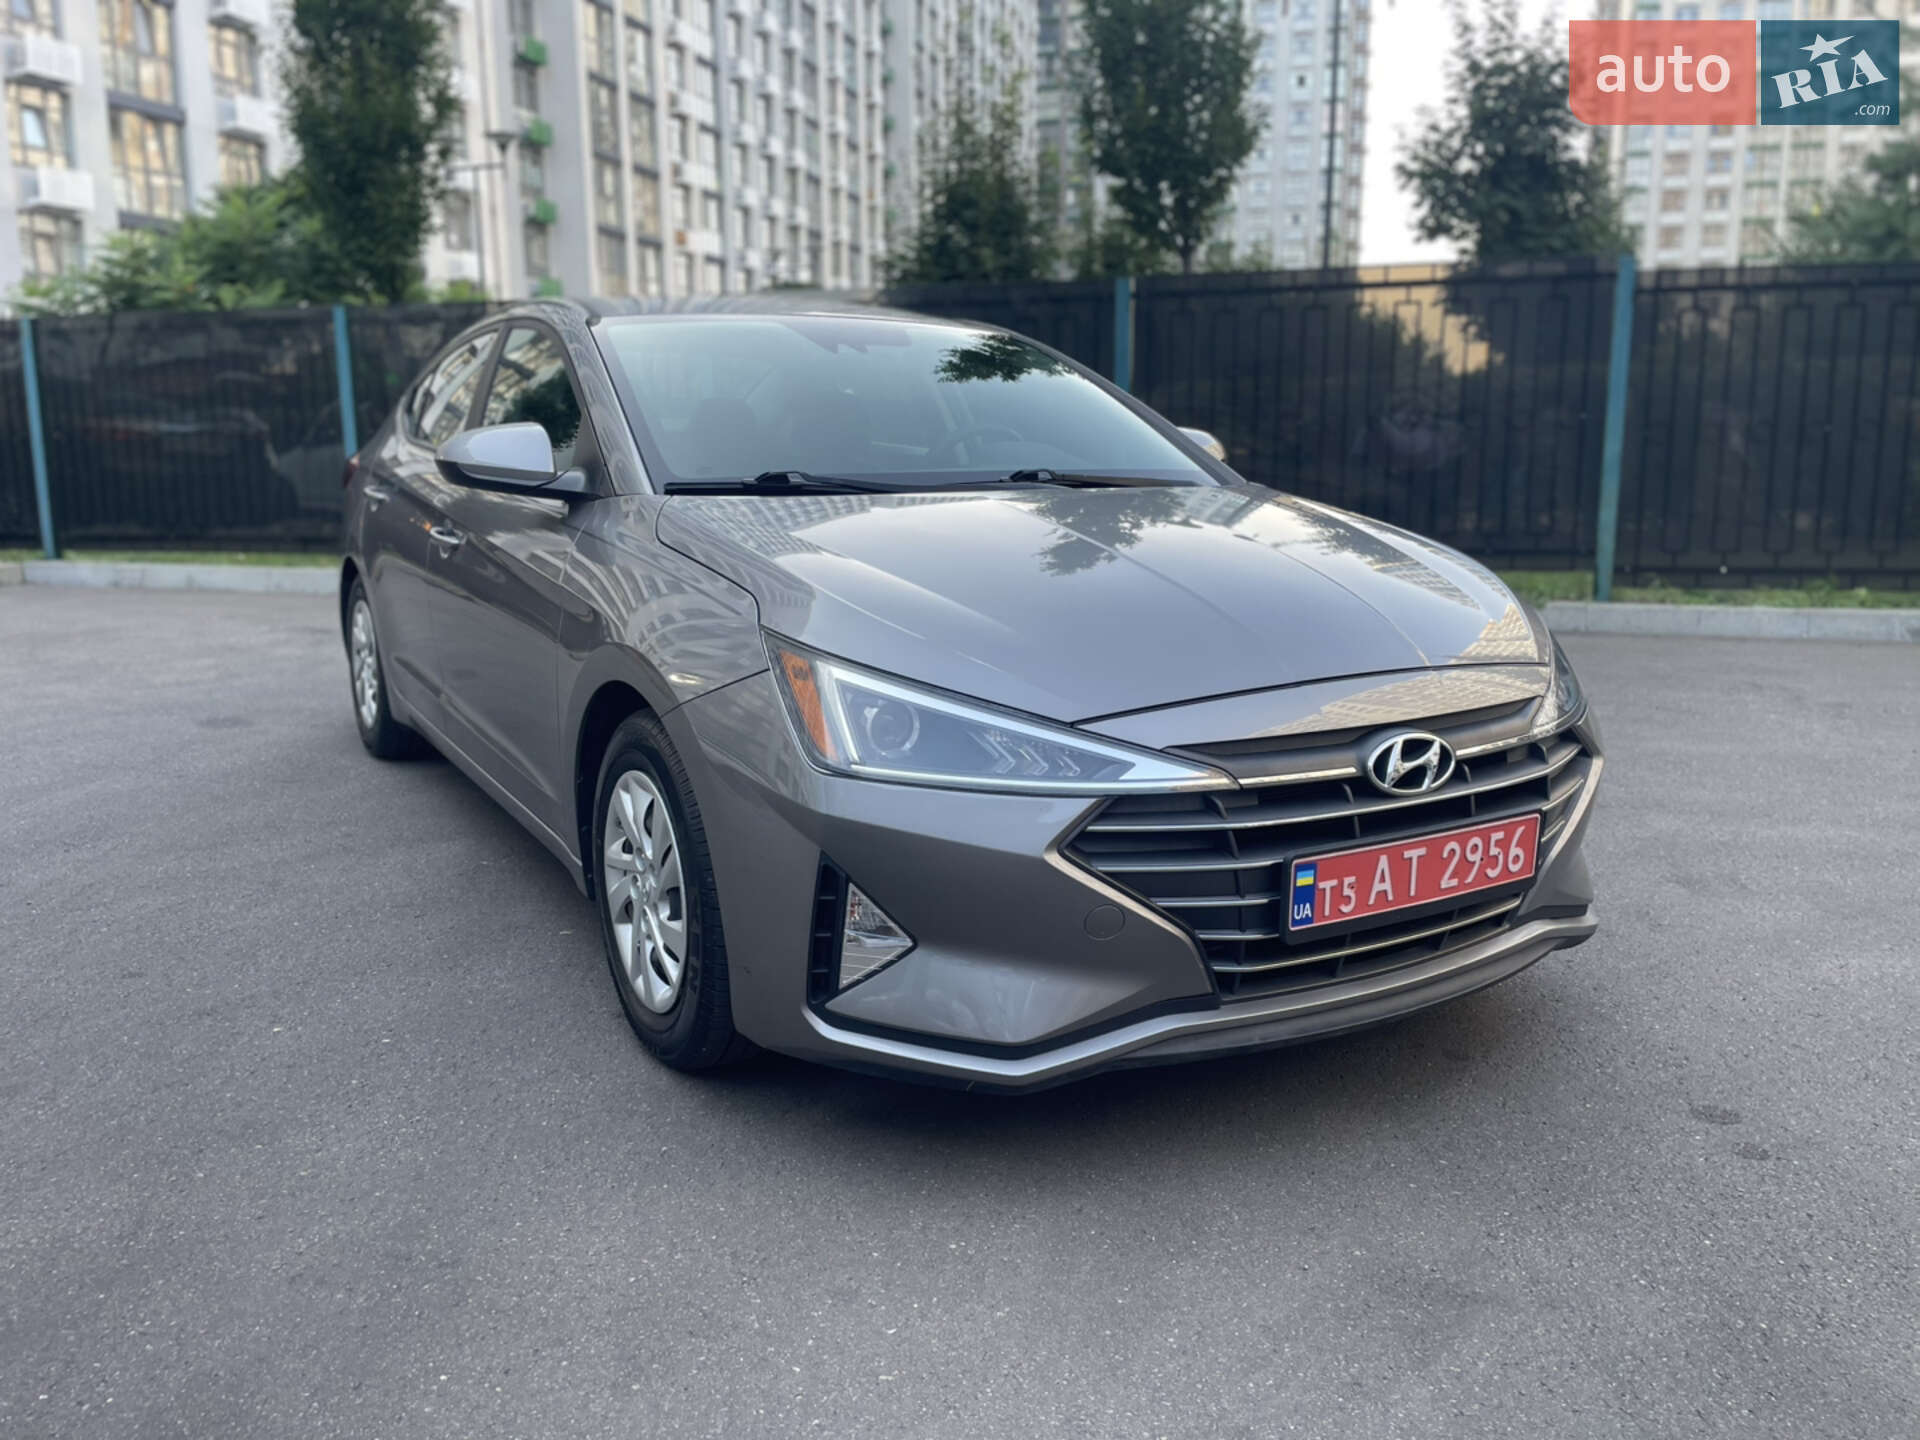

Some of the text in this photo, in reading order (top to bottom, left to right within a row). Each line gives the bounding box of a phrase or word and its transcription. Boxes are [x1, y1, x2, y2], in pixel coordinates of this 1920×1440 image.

[1318, 825, 1526, 917] T5 AT 2956
[1293, 901, 1312, 920] UA
